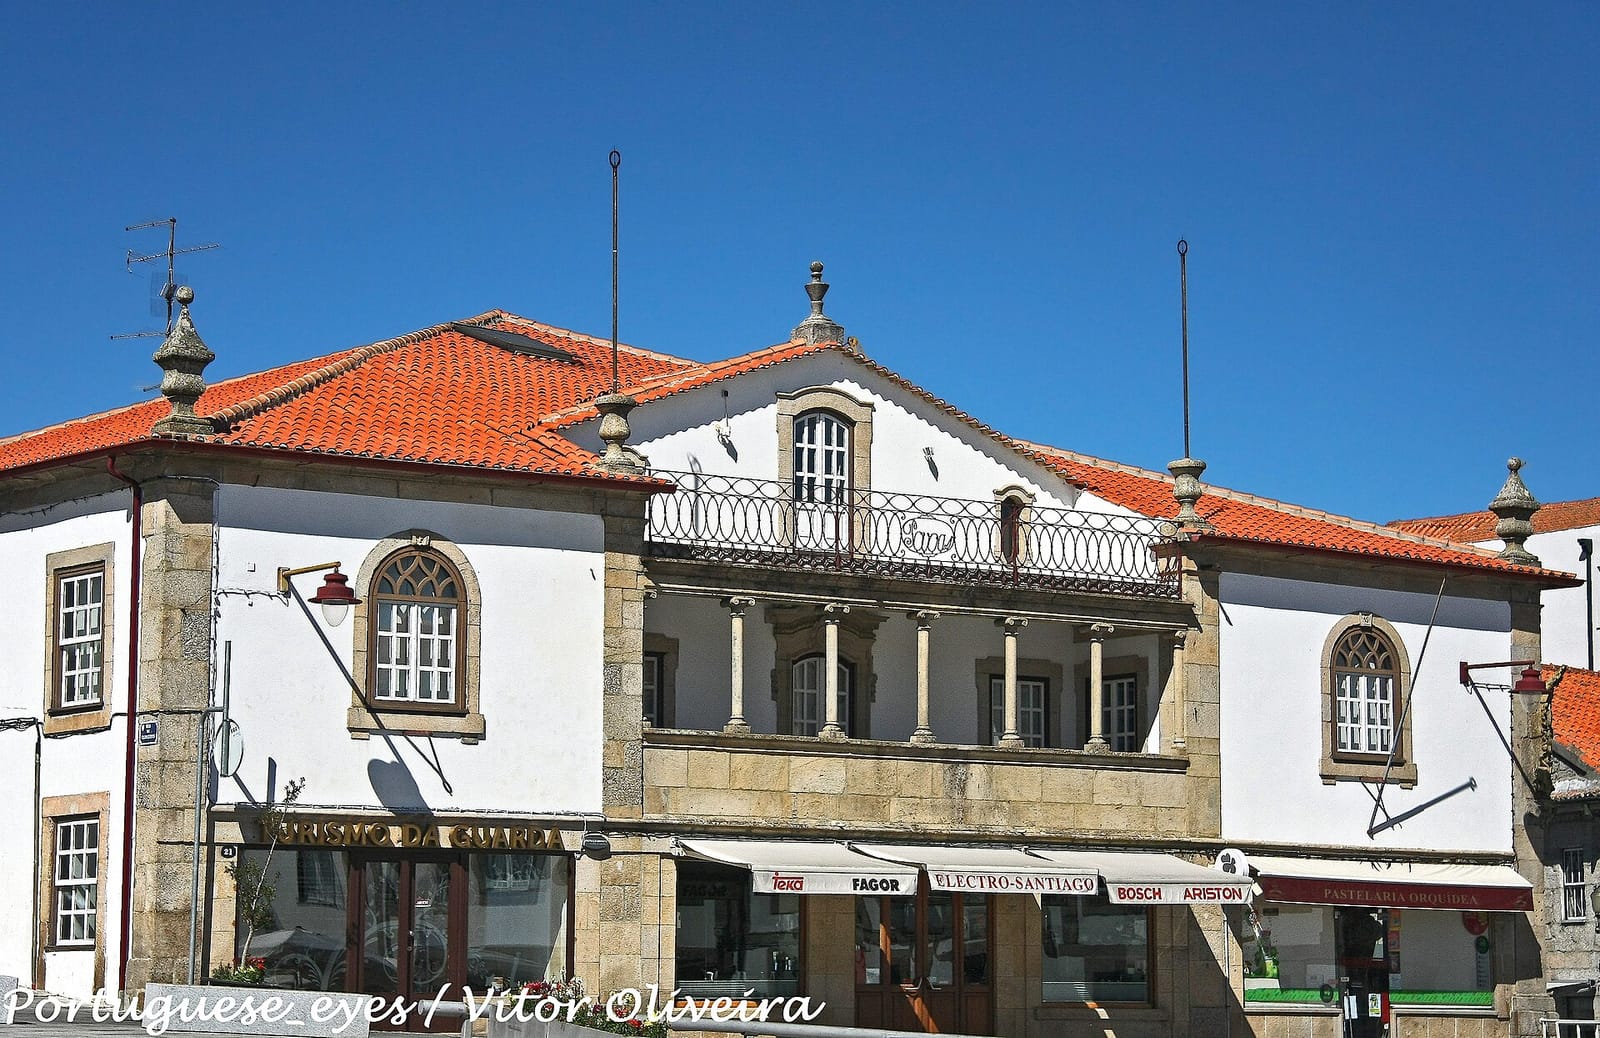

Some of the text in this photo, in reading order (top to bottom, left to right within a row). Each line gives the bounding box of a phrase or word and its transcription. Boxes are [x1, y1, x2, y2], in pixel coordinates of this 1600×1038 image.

[402, 823, 440, 847] DA
[450, 824, 565, 850] GUARDA
[852, 878, 900, 892] FAGOR
[935, 874, 1094, 891] ELECTRO-SANTIAGO
[1117, 887, 1242, 901] BOSCH ARISTON
[1324, 888, 1406, 902] PASTELARIA
